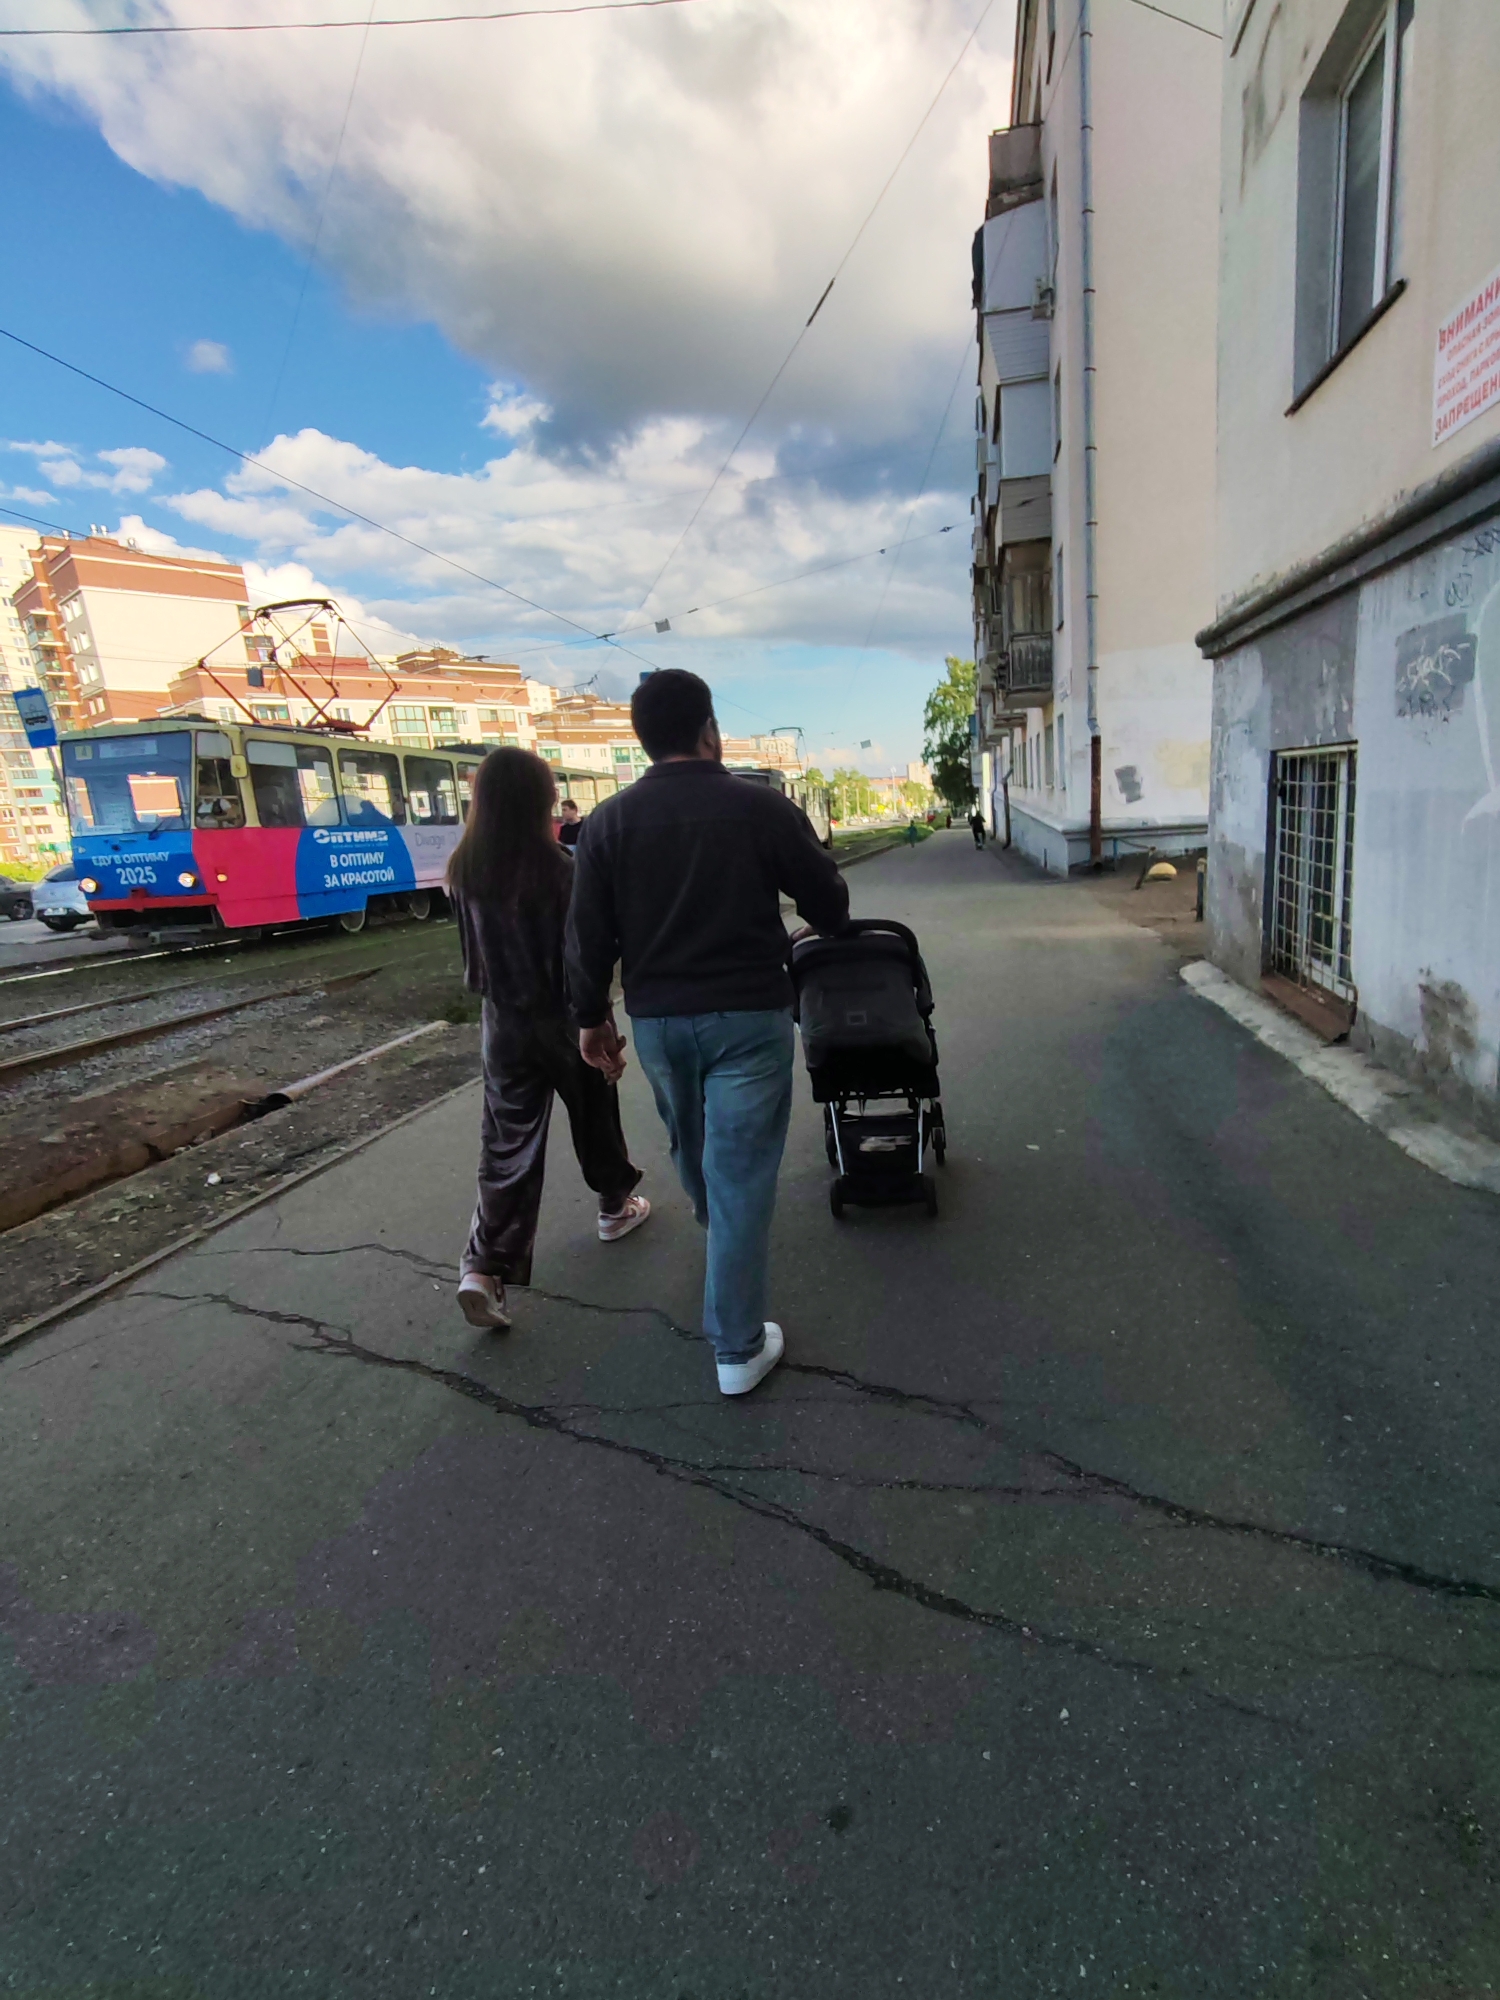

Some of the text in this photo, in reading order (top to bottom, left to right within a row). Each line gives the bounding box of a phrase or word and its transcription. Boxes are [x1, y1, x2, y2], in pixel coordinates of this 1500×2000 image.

[1435, 369, 1500, 437] ЗАПРЕЩЕН
[92, 851, 169, 867] ЕДУ В ОПТИМУ
[329, 851, 385, 868] В ОПТИМУ
[116, 866, 157, 885] 2025
[324, 866, 395, 888] ЗА КРАСОТОЙ
